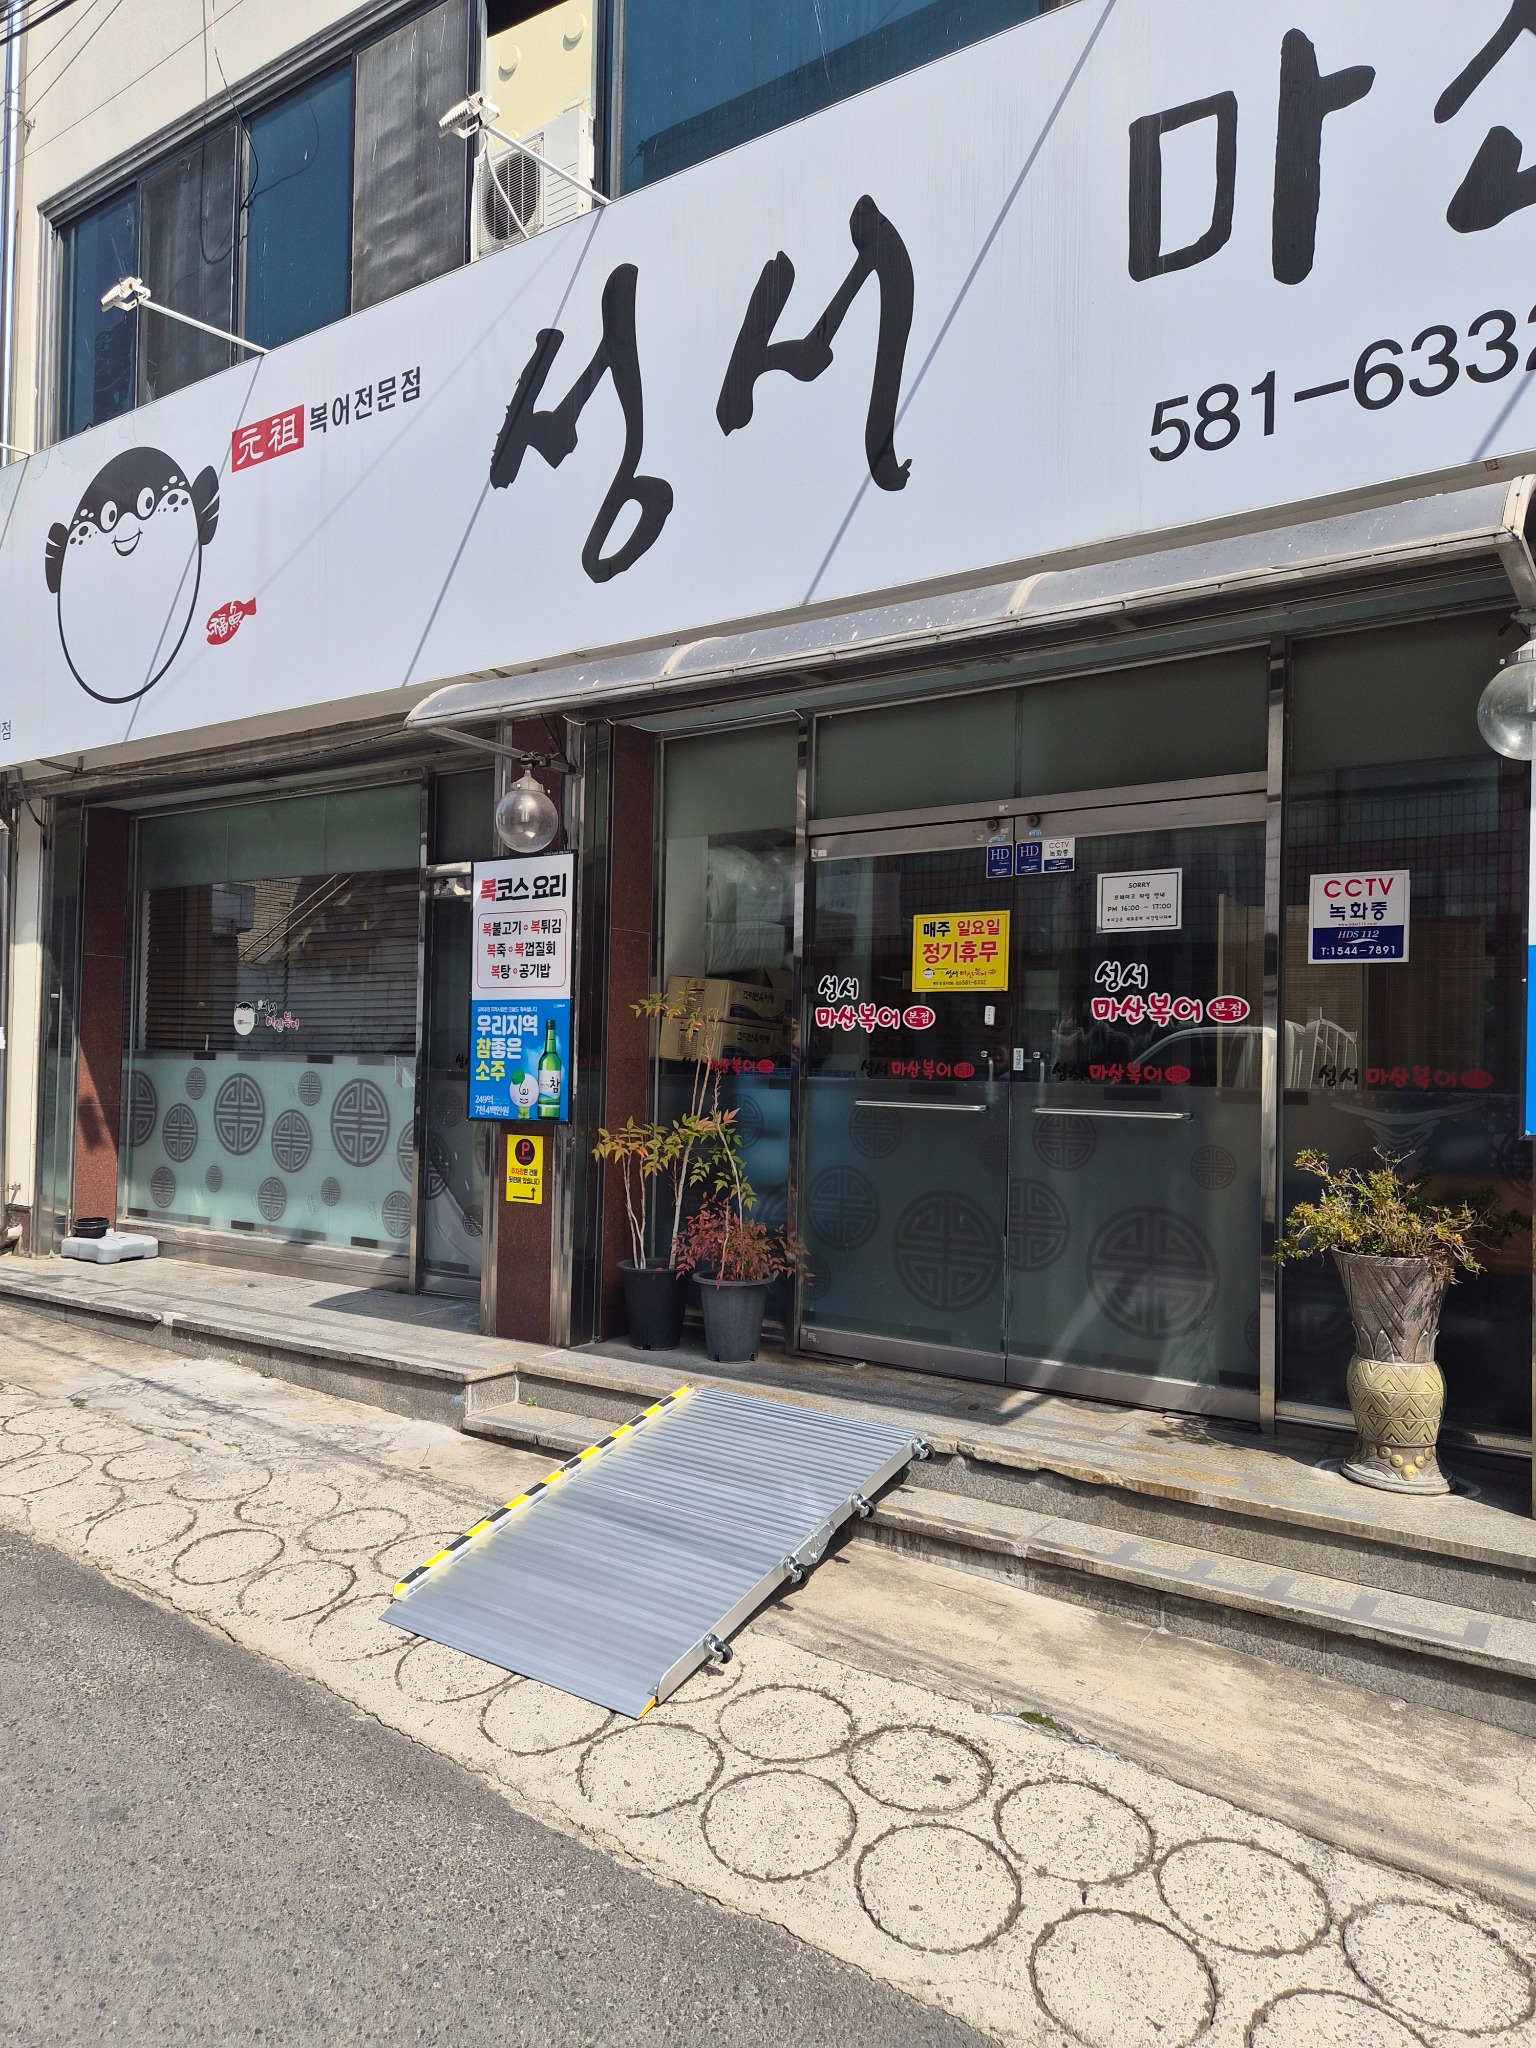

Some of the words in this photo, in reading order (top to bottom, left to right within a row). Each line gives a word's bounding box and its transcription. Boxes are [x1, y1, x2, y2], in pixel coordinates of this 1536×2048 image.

[490, 194, 914, 583] 성서
[1149, 302, 1536, 462] 581-633
[309, 366, 421, 433] 복어전문점
[237, 413, 299, 465] 元祖
[991, 848, 1010, 861] HD
[1020, 845, 1039, 857] HD
[1048, 841, 1069, 849] CCTV
[480, 877, 529, 902] 복코스
[531, 873, 566, 899] 요리
[1128, 881, 1151, 889] SORRY
[1324, 877, 1394, 898] CCTV
[1121, 904, 1140, 912] 16:00
[1152, 902, 1172, 910] 17:00
[1329, 901, 1388, 921] 녹화중
[482, 920, 521, 936] 복불고기
[530, 918, 562, 934] 복튀김
[923, 921, 951, 938] 매주
[956, 918, 1000, 937] 일요일
[1337, 929, 1359, 939] HDS
[1361, 929, 1380, 939] 112
[486, 943, 506, 958] 복죽
[514, 941, 556, 957] 복껍질회
[922, 940, 999, 965] 정기휴무
[1320, 945, 1396, 956] T:1544-7891
[491, 964, 511, 979] 복탕
[519, 963, 551, 979] 공기밥
[1094, 961, 1149, 993] 성서
[818, 975, 859, 1003] 성서
[815, 1002, 900, 1033] 마산복어
[906, 1009, 931, 1025] 본점
[1091, 992, 1203, 1028] 마산복어
[1211, 1001, 1243, 1018] 본점
[476, 1014, 538, 1036] 우리지역
[476, 1037, 522, 1059] 참좋은
[475, 1060, 506, 1081] 소주
[891, 1059, 951, 1079] 마산복어
[1089, 1062, 1162, 1084] 마산복어
[1318, 1064, 1358, 1087] 성서
[1365, 1065, 1457, 1091] 마산복어
[549, 1076, 561, 1093] 참
[475, 1094, 494, 1105] 249억
[475, 1105, 510, 1116] 7천4백만원
[521, 1141, 531, 1157] P
